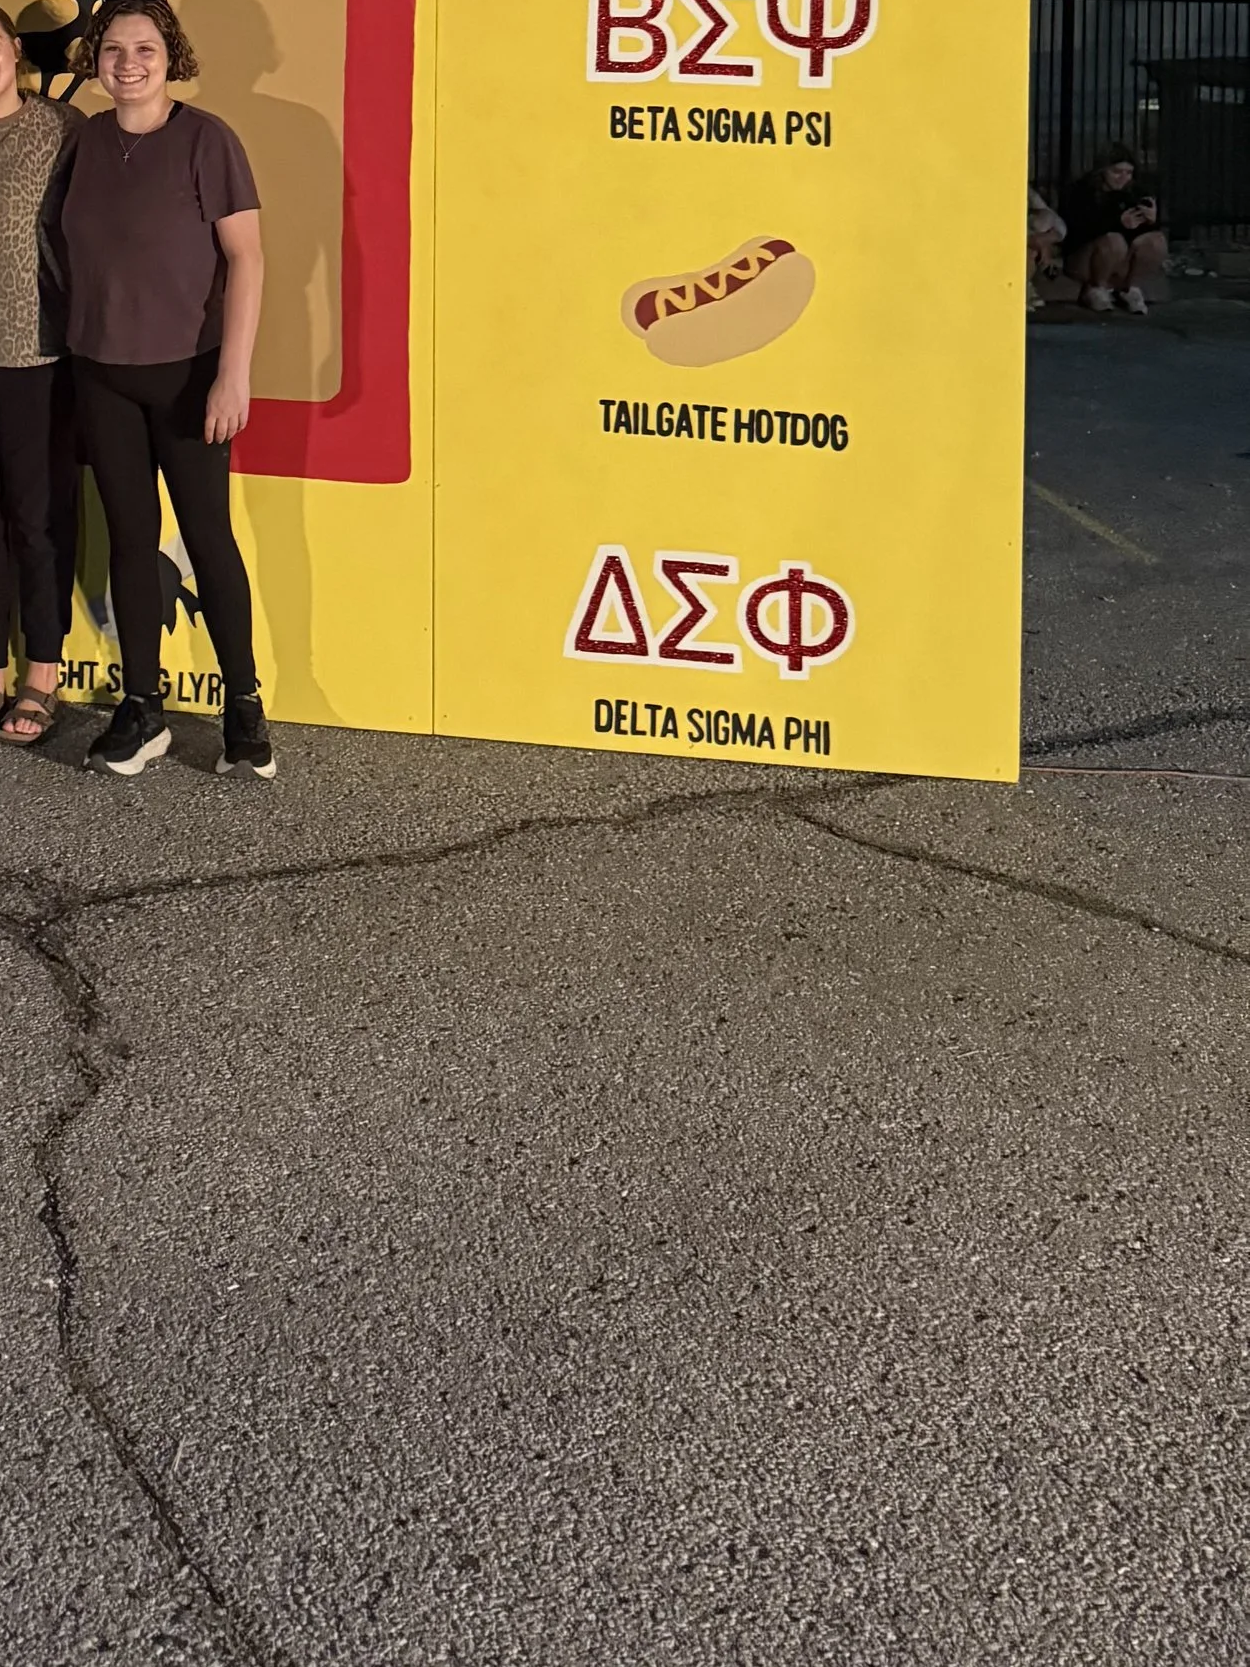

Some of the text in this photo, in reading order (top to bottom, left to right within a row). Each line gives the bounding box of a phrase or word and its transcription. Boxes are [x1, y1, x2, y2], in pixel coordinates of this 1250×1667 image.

[609, 104, 832, 147] BETA SIGMA PSI
[598, 398, 850, 452] TAILGATE HOTDOG
[106, 663, 170, 699] SG
[593, 697, 831, 757] DELTA SIGMA PHI
